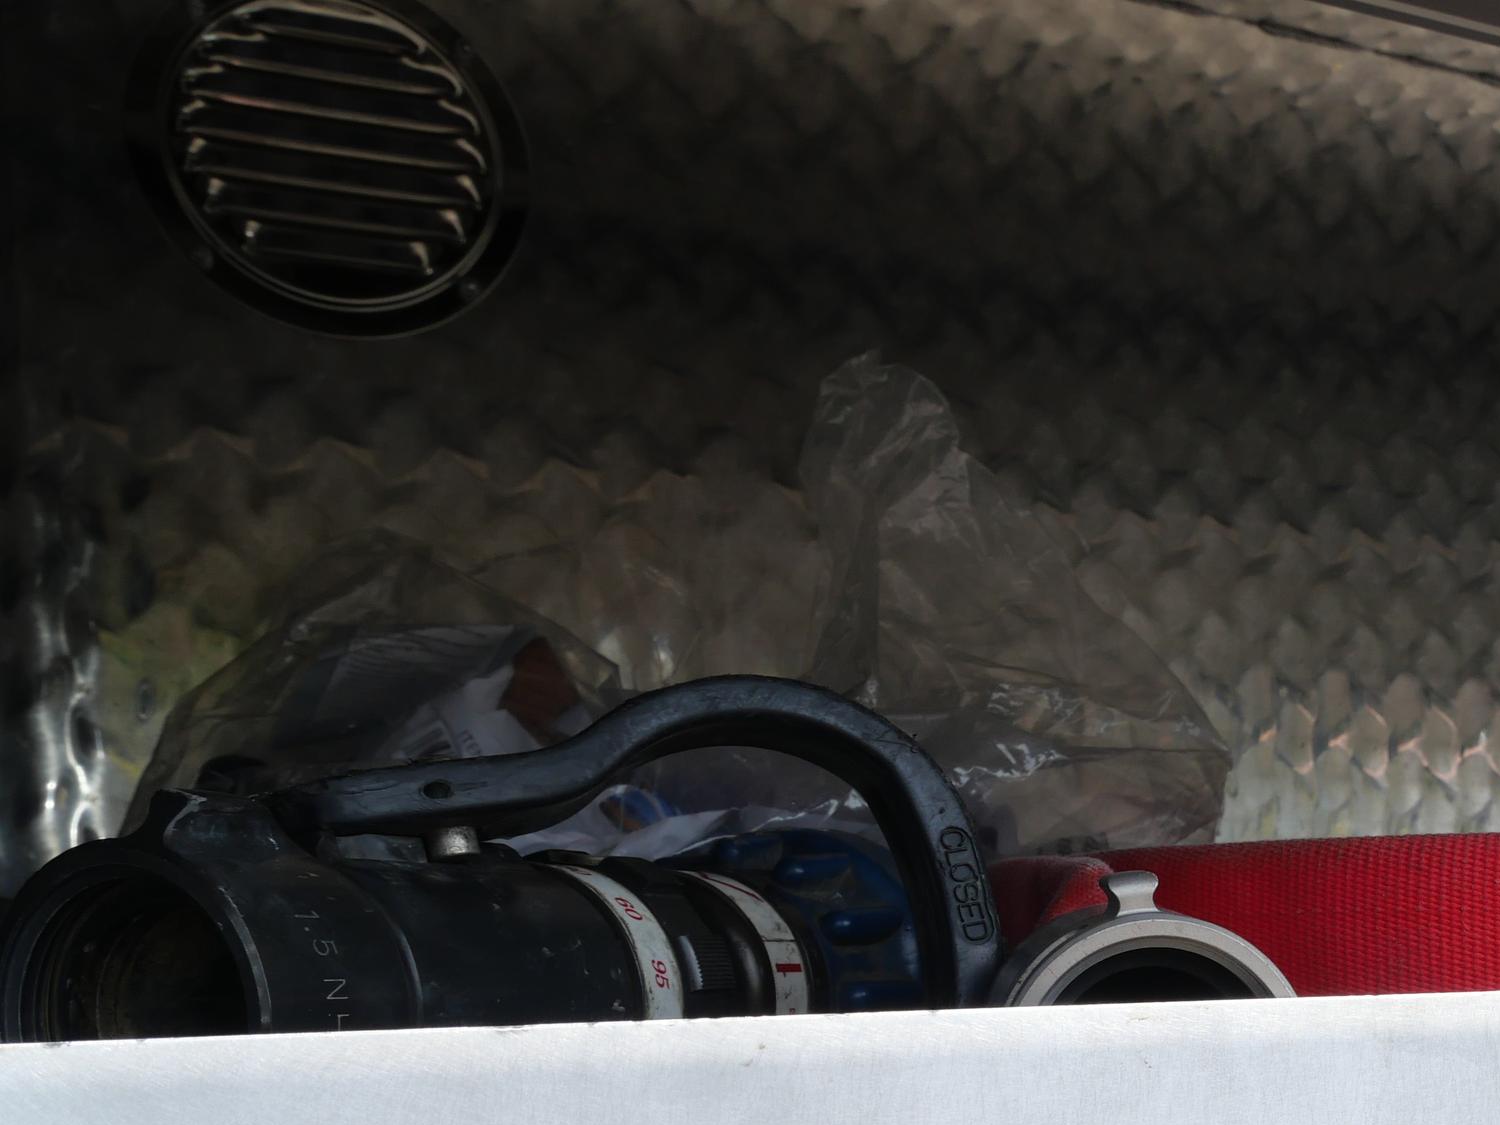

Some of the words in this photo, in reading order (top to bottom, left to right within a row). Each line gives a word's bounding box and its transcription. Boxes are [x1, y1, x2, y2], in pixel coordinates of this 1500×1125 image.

[940, 831, 987, 941] CLOSED
[615, 896, 643, 921] 60
[294, 910, 338, 956] 1.5
[651, 960, 671, 990] 95
